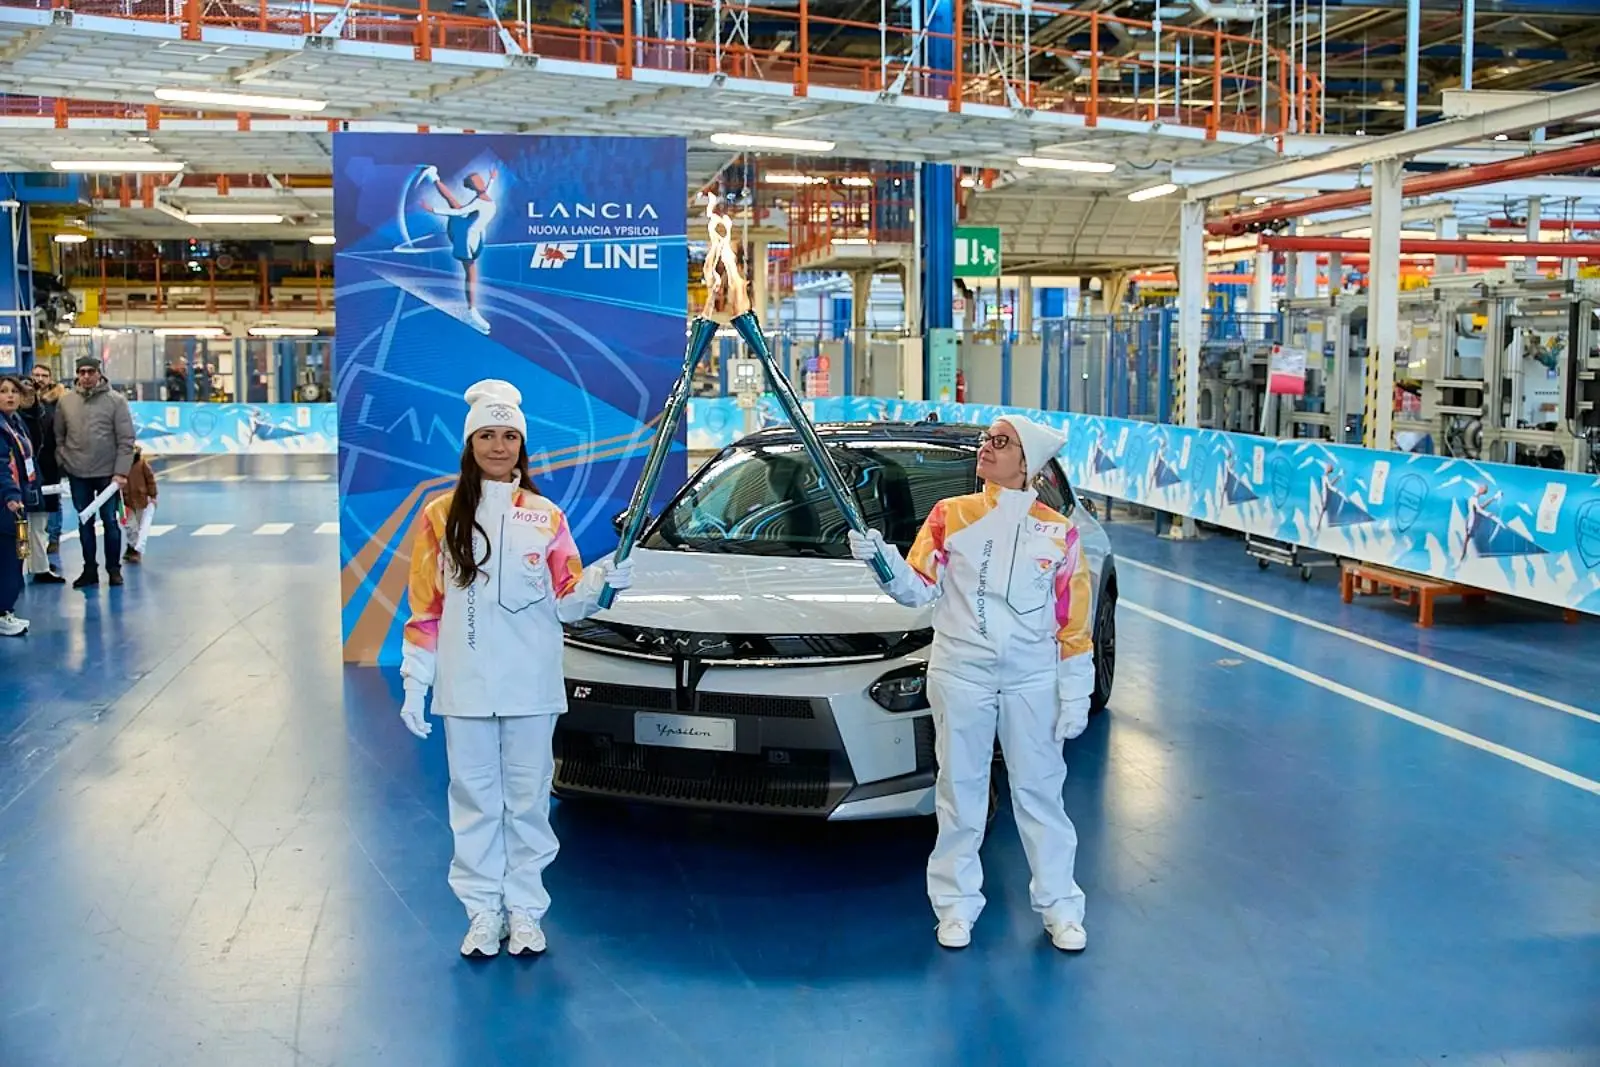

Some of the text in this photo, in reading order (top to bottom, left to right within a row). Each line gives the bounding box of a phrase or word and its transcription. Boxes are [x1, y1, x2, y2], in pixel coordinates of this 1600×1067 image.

[528, 202, 659, 219] LANCIA
[528, 225, 659, 236] NUOVA LANCIA YPSILON
[584, 243, 658, 269] LINE
[977, 539, 993, 640] MILANO CORTINA 2026
[467, 606, 476, 651] MILANO
[635, 633, 753, 649] LANCIA
[655, 723, 712, 737] Ypsilon
